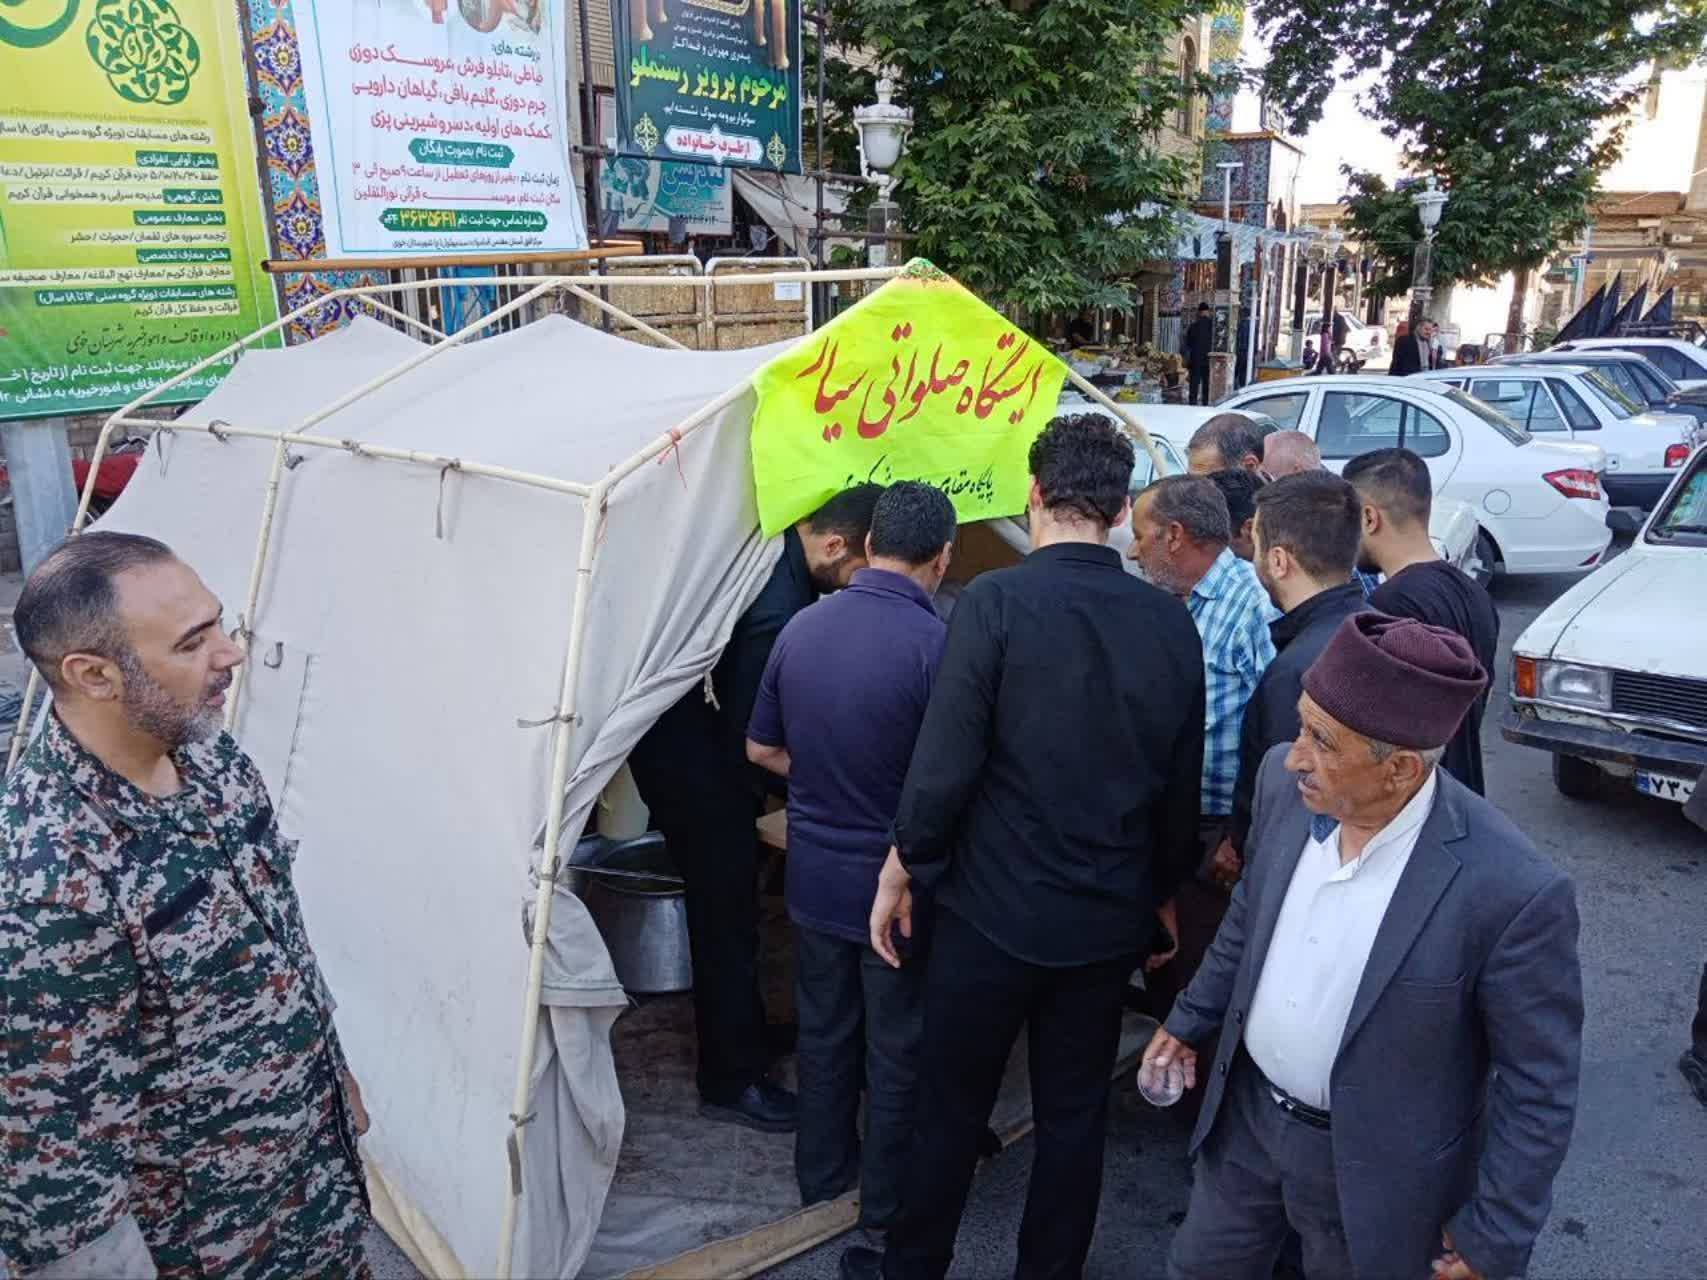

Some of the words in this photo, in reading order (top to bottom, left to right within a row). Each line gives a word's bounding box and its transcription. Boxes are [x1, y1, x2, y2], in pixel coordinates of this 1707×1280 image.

[348, 43, 379, 63] دوزی
[457, 56, 486, 78] فرش
[629, 43, 690, 95] رستملو
[351, 74, 396, 98] دارویی
[398, 76, 439, 100] گیاهان
[692, 63, 738, 105] پرویز
[739, 73, 788, 110] مرحوم
[527, 98, 547, 118] چرم
[370, 109, 393, 134] پزی
[393, 111, 439, 134] شیرینی
[500, 117, 524, 140] های
[81, 123, 103, 139] گروه
[127, 126, 168, 141] مسابقات
[168, 129, 190, 143] های
[190, 131, 210, 144] رشته
[418, 139, 446, 158] رایگان
[675, 132, 717, 151] خانواده
[487, 146, 504, 161] ثبت
[89, 168, 112, 181] کریم
[407, 164, 434, 177] ساعت
[7, 186, 31, 201] کریم
[31, 186, 54, 201] قرآن
[56, 187, 98, 201] همخوانی
[162, 230, 182, 243] های
[203, 231, 227, 242] ترجمه
[14, 273, 48, 283] صحیفه
[166, 266, 186, 280] کریم
[187, 265, 204, 279] قرآن
[204, 267, 232, 279] معارف
[160, 287, 198, 298] مسابقات
[198, 286, 216, 298] های
[215, 285, 236, 298] رشته
[133, 303, 154, 319] کریم
[87, 322, 126, 356] شهرستان
[169, 323, 209, 345] اوقاف
[65, 330, 89, 355] خوی
[30, 365, 59, 385] تاریخ
[58, 364, 70, 381] از
[70, 364, 88, 381] نام
[88, 361, 113, 377] ثبت
[115, 361, 144, 375] جهت
[856, 322, 971, 440] صلواتی
[955, 332, 1045, 426] ایستگاه
[15, 386, 53, 405] نشانی
[53, 388, 67, 398] به
[796, 336, 871, 444] سیار
